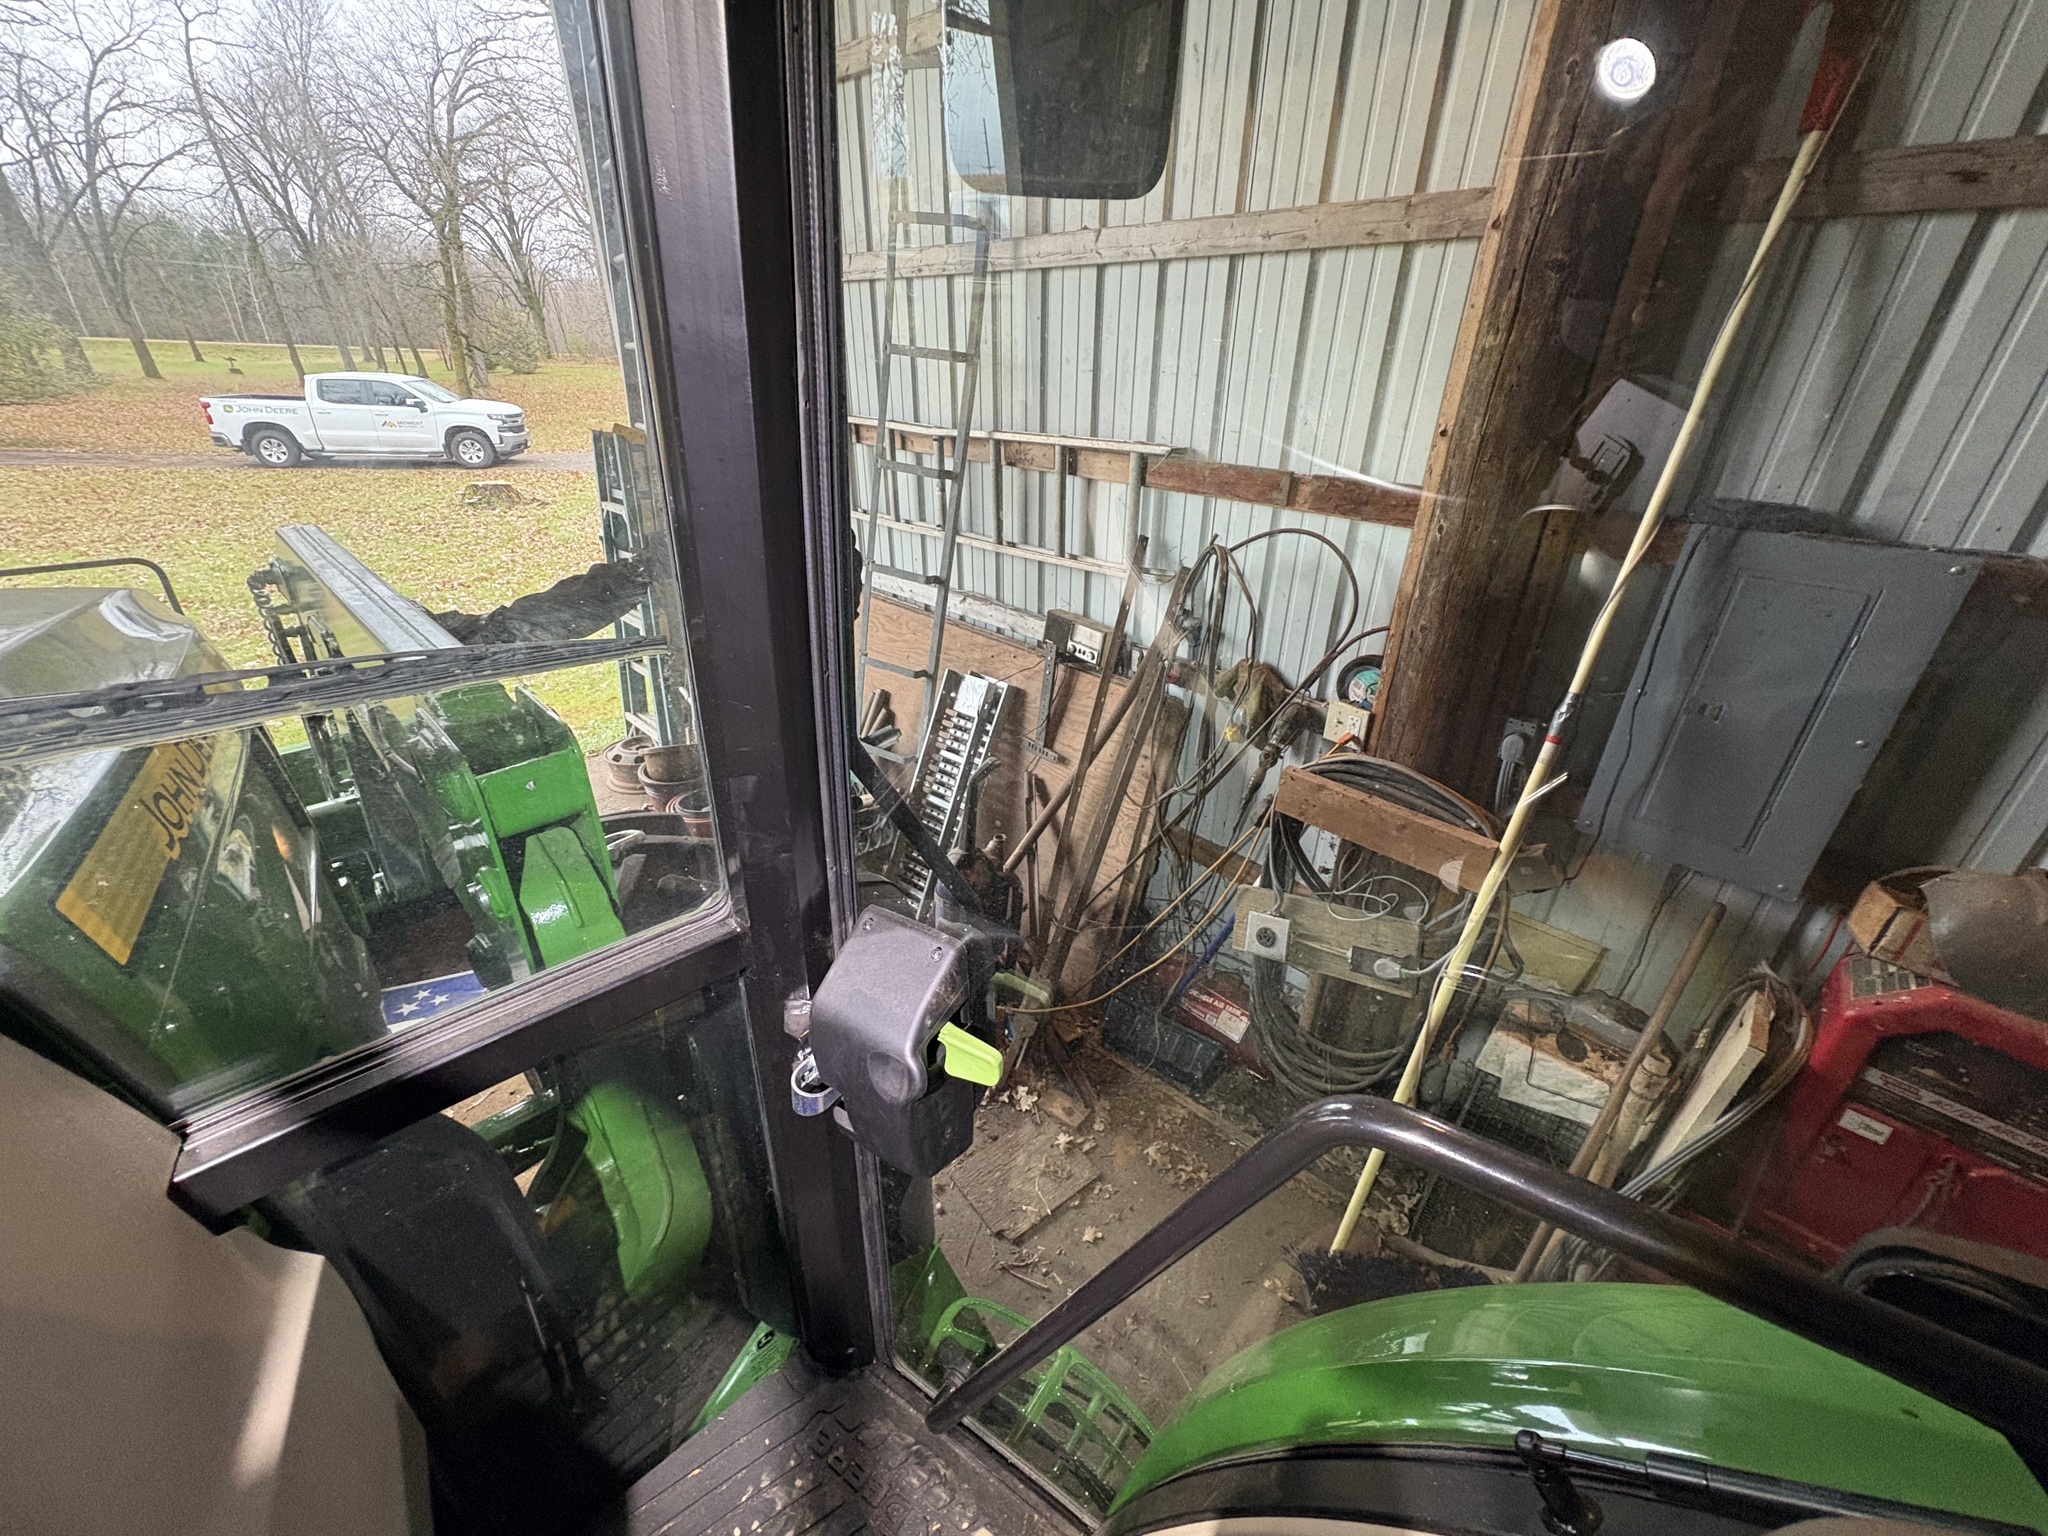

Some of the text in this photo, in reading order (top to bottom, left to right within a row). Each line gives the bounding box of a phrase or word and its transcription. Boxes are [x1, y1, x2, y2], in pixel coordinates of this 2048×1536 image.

[236, 405, 299, 415] JOHN DEERE
[139, 757, 203, 852] JOHN
